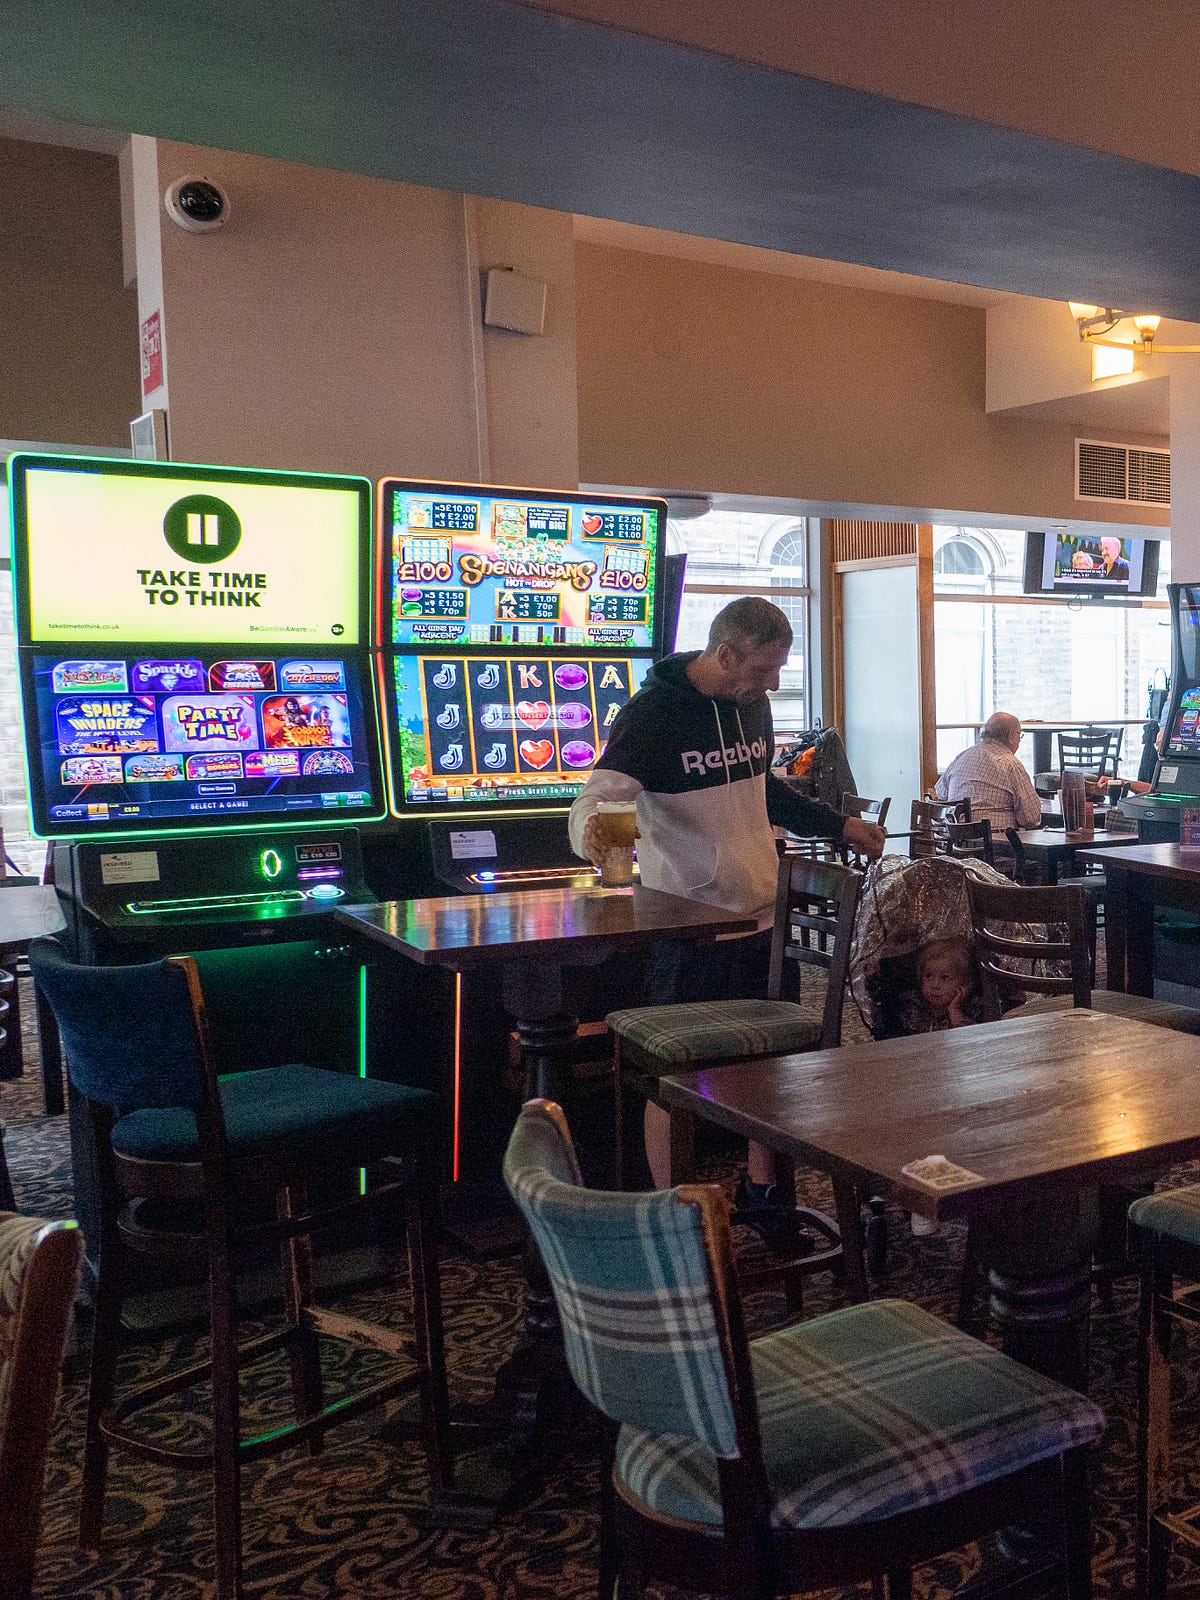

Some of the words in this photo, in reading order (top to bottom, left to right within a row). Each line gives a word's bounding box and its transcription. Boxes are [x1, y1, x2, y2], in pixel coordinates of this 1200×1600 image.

[446, 505, 477, 513] £10.00
[448, 513, 475, 521] £2.00
[618, 515, 642, 524] £2.00
[448, 521, 474, 529] £1.20
[529, 519, 547, 530] WIN
[548, 520, 566, 531] BIG!
[619, 523, 642, 531] £1.50
[618, 531, 641, 539] £1.00
[398, 562, 452, 581] £100
[137, 569, 201, 587] TAKE
[208, 571, 267, 589] TIME
[505, 578, 525, 587] HOT
[532, 579, 556, 588] DROP
[601, 571, 647, 590] £100
[145, 589, 180, 606] TO
[185, 590, 261, 608] THINK
[438, 592, 465, 600] £1.50
[533, 595, 557, 603] £1.00
[438, 600, 464, 608] £1.00
[537, 602, 553, 611] 70p
[623, 598, 639, 606] 70p
[443, 607, 460, 615] 70p
[537, 609, 553, 618] 50p
[623, 605, 639, 613] 50p
[623, 613, 638, 621] 20p
[48, 623, 120, 631] taketimetothink.co.uk
[139, 662, 198, 682] Sparkle
[517, 664, 543, 689] K
[225, 672, 262, 682] CASH
[599, 664, 625, 690] A
[80, 702, 133, 718] SPACE
[177, 705, 241, 723] PARTY
[520, 712, 548, 720] INSERT
[67, 717, 150, 730] INVADERS
[184, 722, 238, 739] TIME
[262, 753, 296, 767] MEGA
[681, 736, 767, 775] Reebok
[504, 788, 526, 796] Press
[560, 787, 577, 795] Play
[190, 803, 219, 811] SELECT
[226, 800, 249, 809] GAME!
[55, 809, 83, 818] Collect
